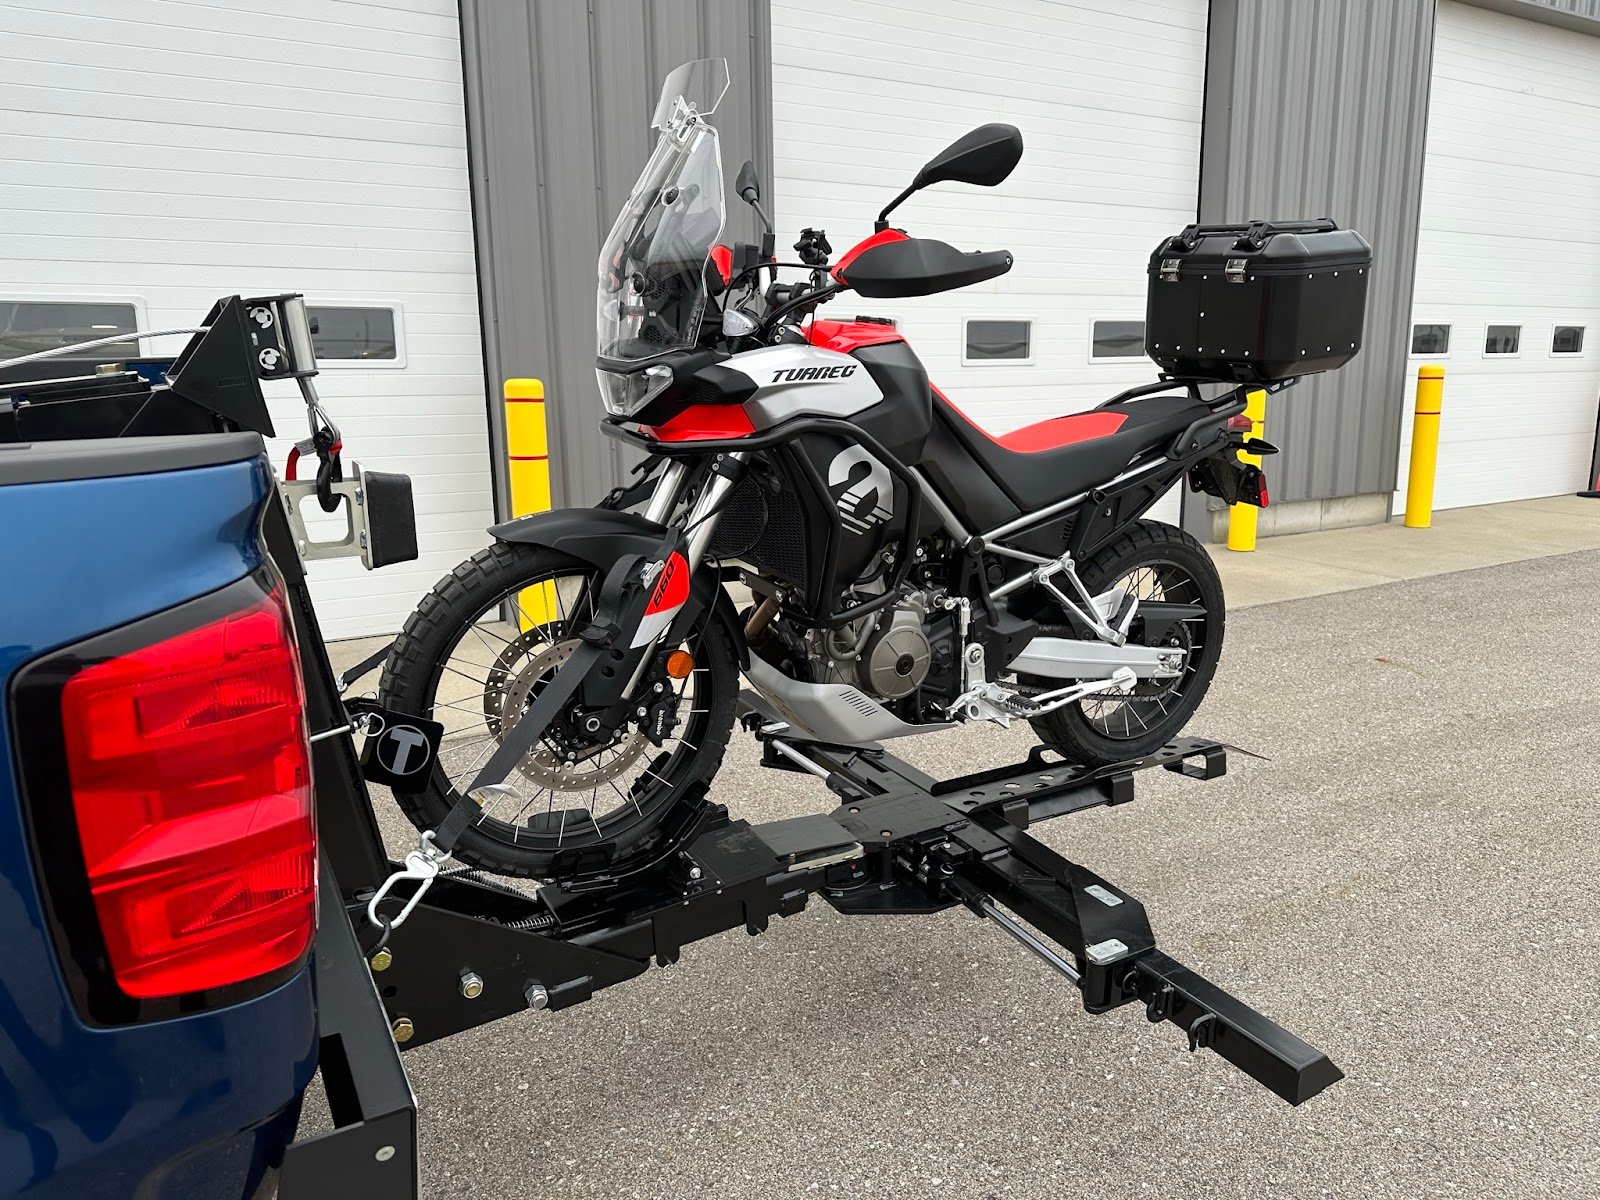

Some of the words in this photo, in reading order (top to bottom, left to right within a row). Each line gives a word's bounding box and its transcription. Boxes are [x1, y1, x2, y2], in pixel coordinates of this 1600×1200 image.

[771, 365, 857, 383] TUAREG
[653, 560, 675, 608] 660
[656, 709, 666, 736] brembo
[390, 727, 425, 775] T
